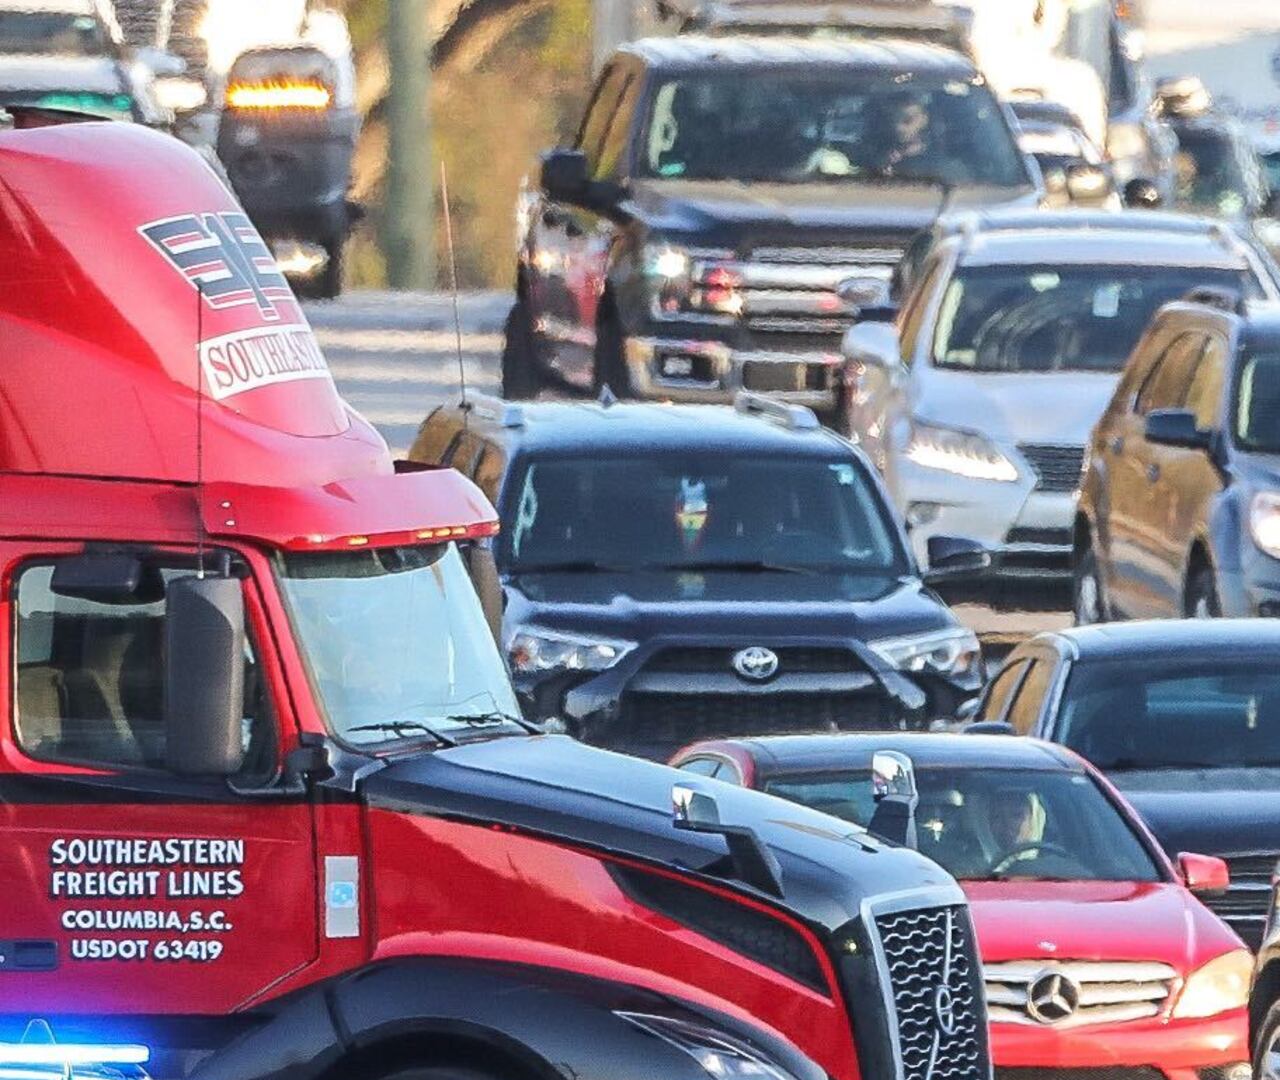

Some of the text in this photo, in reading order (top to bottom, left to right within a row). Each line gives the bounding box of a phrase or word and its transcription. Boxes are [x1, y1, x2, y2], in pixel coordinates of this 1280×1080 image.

[51, 838, 245, 865] SOUTHEASTERN
[52, 870, 244, 896] FREIGHT LINES
[72, 938, 223, 961] USDOT 63419
